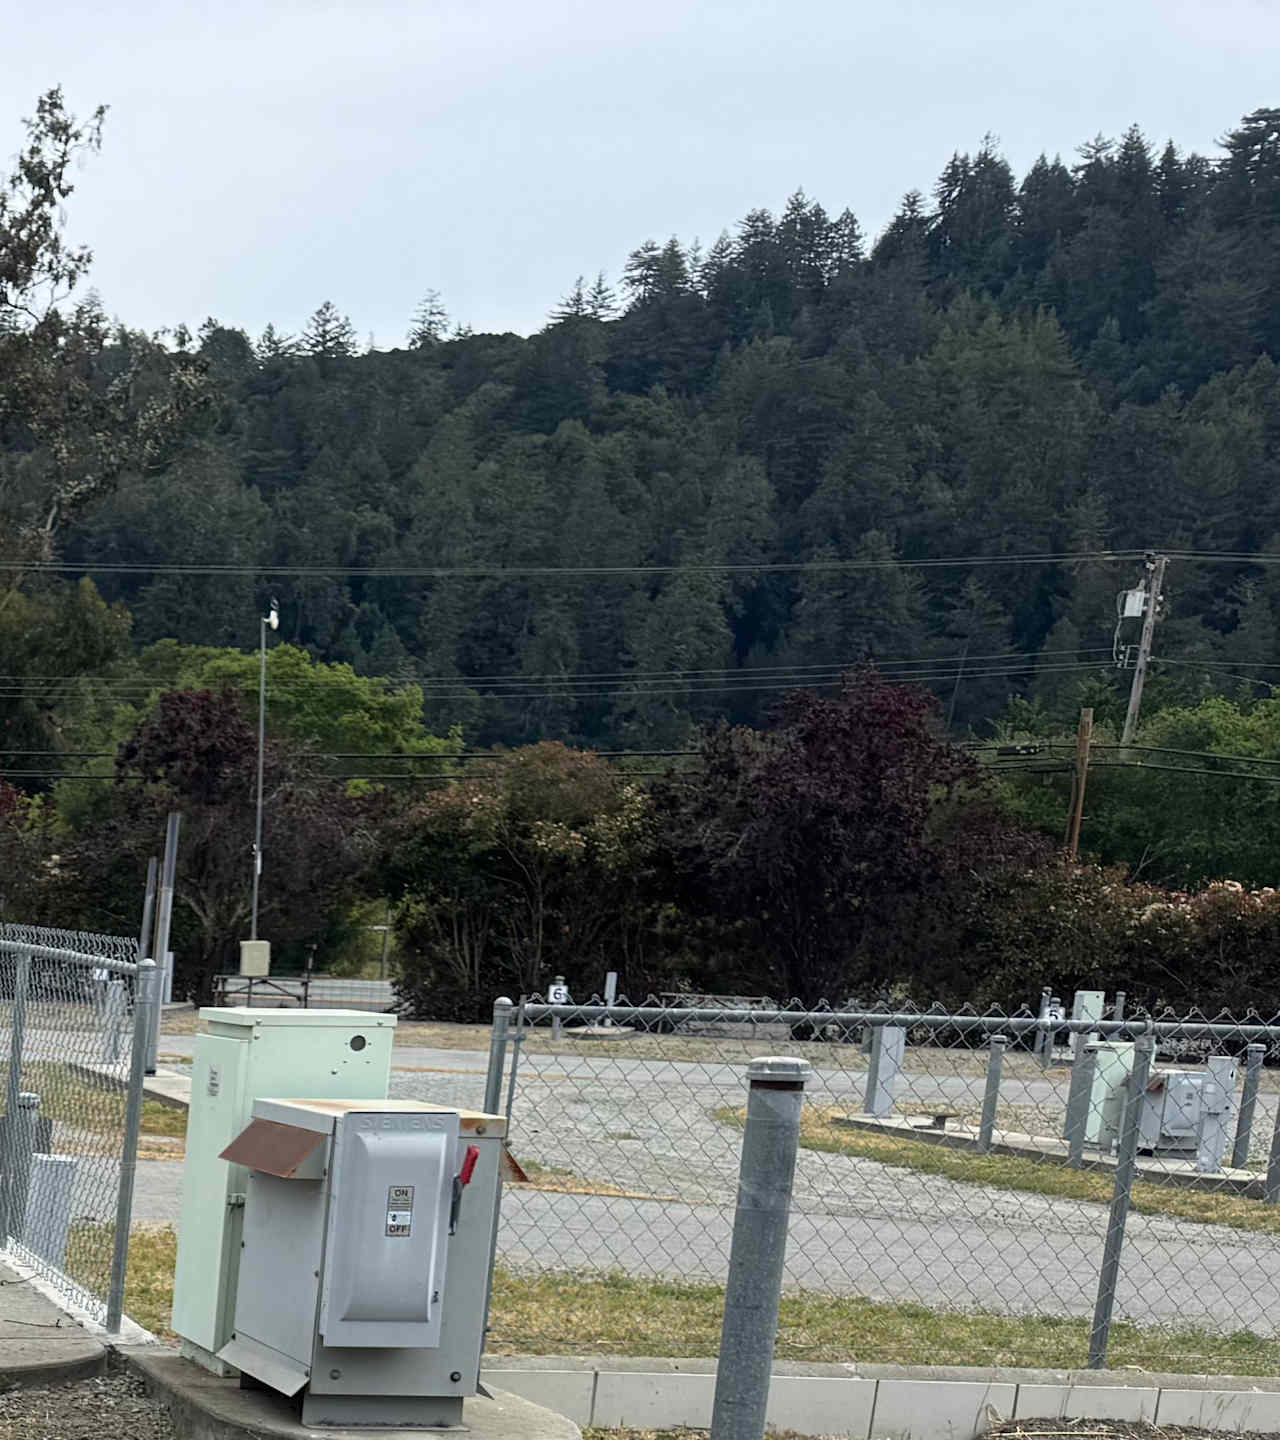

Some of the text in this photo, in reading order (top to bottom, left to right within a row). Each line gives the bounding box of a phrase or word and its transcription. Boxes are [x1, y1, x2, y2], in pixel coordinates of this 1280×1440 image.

[553, 988, 562, 1000] 6
[394, 1188, 409, 1198] ON
[388, 1223, 407, 1233] OFF
